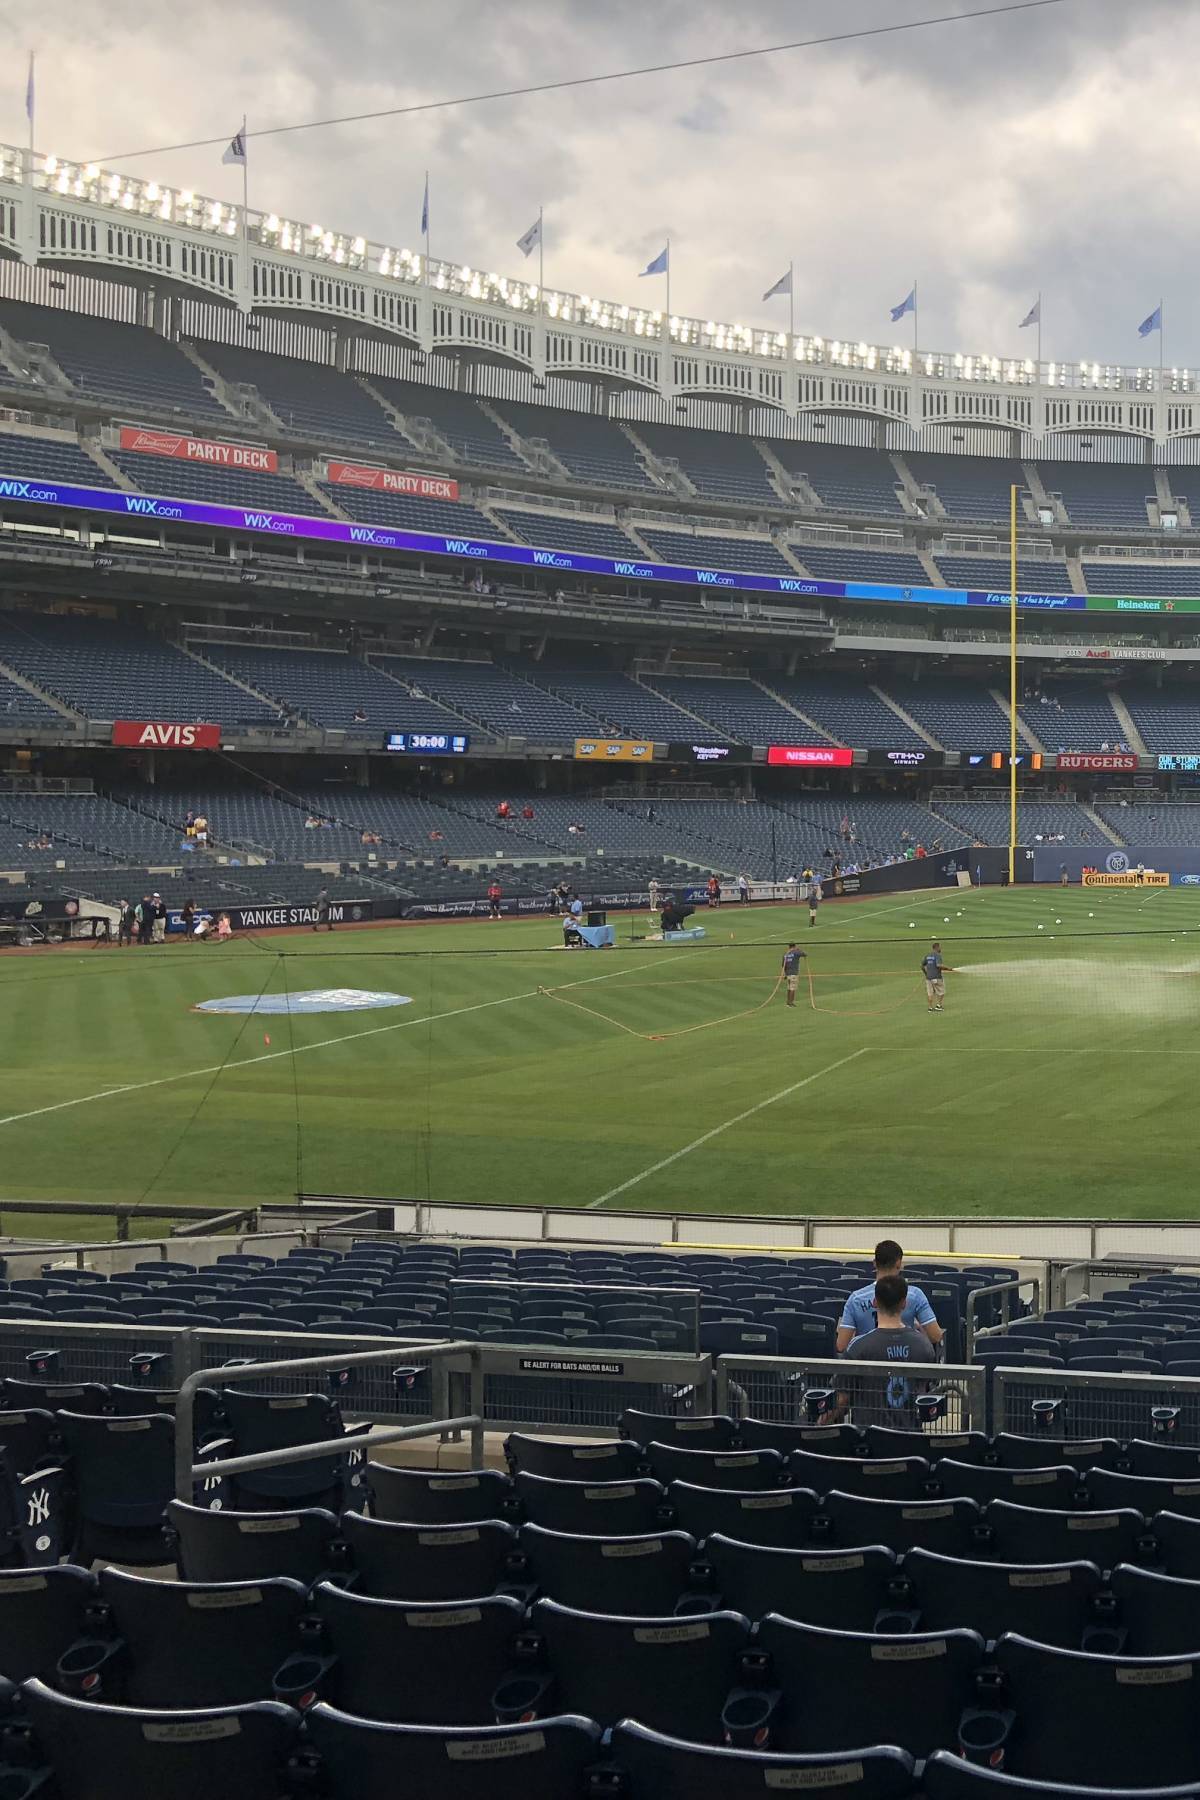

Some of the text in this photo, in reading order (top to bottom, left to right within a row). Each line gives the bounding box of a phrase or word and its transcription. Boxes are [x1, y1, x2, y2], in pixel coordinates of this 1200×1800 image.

[187, 441, 269, 469] PARTY DECK
[383, 473, 451, 497] PARTY DECK
[1117, 599, 1161, 610] Heineken
[1086, 650, 1166, 659] Audi YANKEES CLUB
[139, 725, 195, 745] AVIS
[412, 736, 446, 748] 30:00
[580, 744, 595, 755] SAP
[606, 745, 621, 755] SAP
[631, 746, 646, 756] SAP
[786, 750, 834, 762] NISSAN
[887, 752, 925, 760] ETIHAD
[1060, 756, 1134, 769] RUTGERS
[1085, 874, 1137, 886] Continental
[240, 909, 287, 926] YANKEE
[886, 1345, 909, 1359] RING
[523, 1360, 620, 1372] BE ALERT FOR BATS AND/OR BALLS
